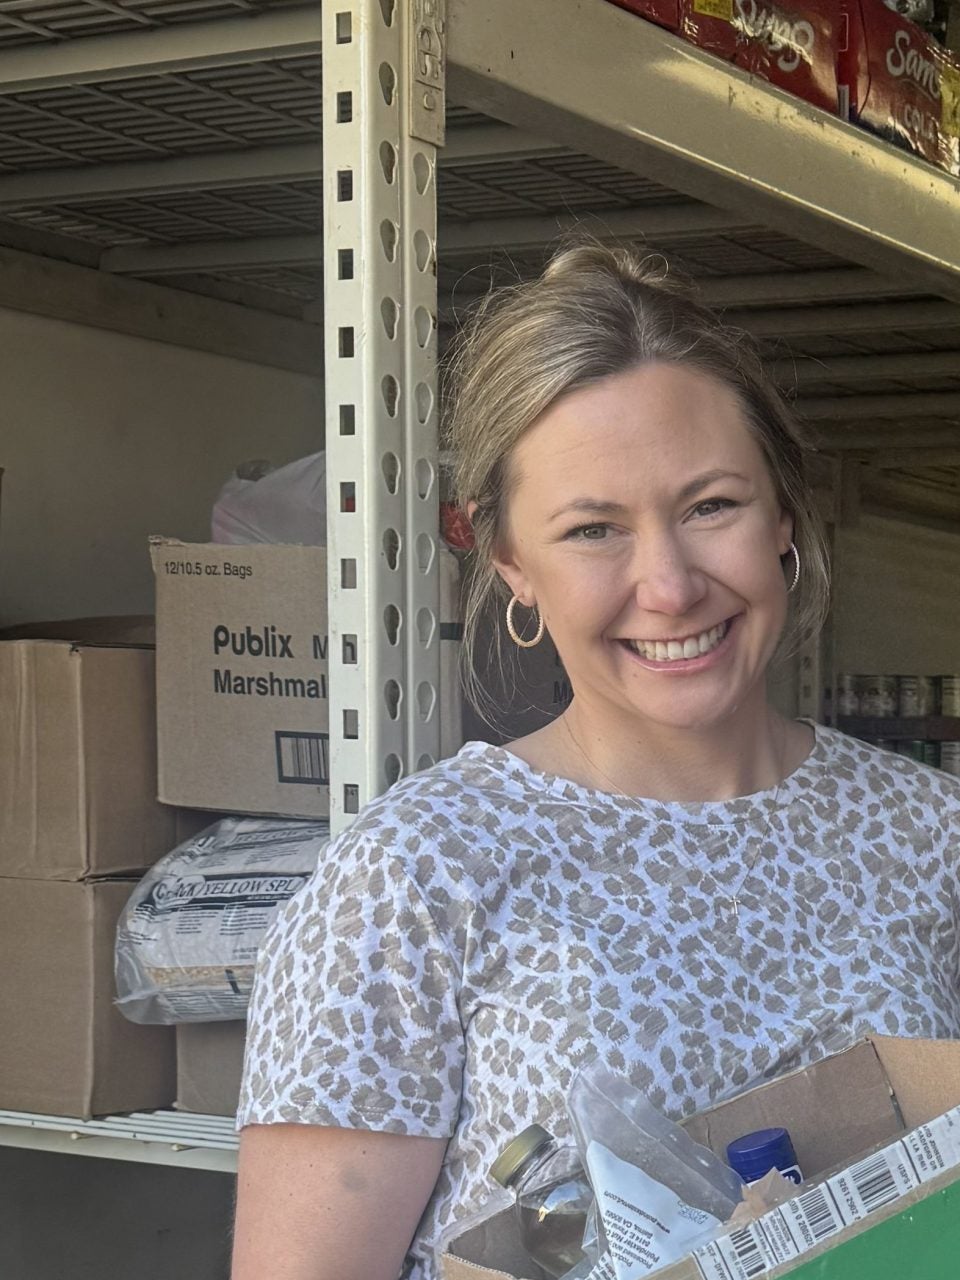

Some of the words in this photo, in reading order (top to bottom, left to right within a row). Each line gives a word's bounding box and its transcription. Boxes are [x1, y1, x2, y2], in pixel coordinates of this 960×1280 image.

[165, 562, 202, 576] 12/10.5
[205, 565, 221, 576] oz.
[224, 563, 253, 579] Bags
[213, 625, 294, 658] Publix
[203, 881, 263, 896] YELLOW
[265, 879, 294, 893] SPL
[896, 1163, 911, 1184] USPS
